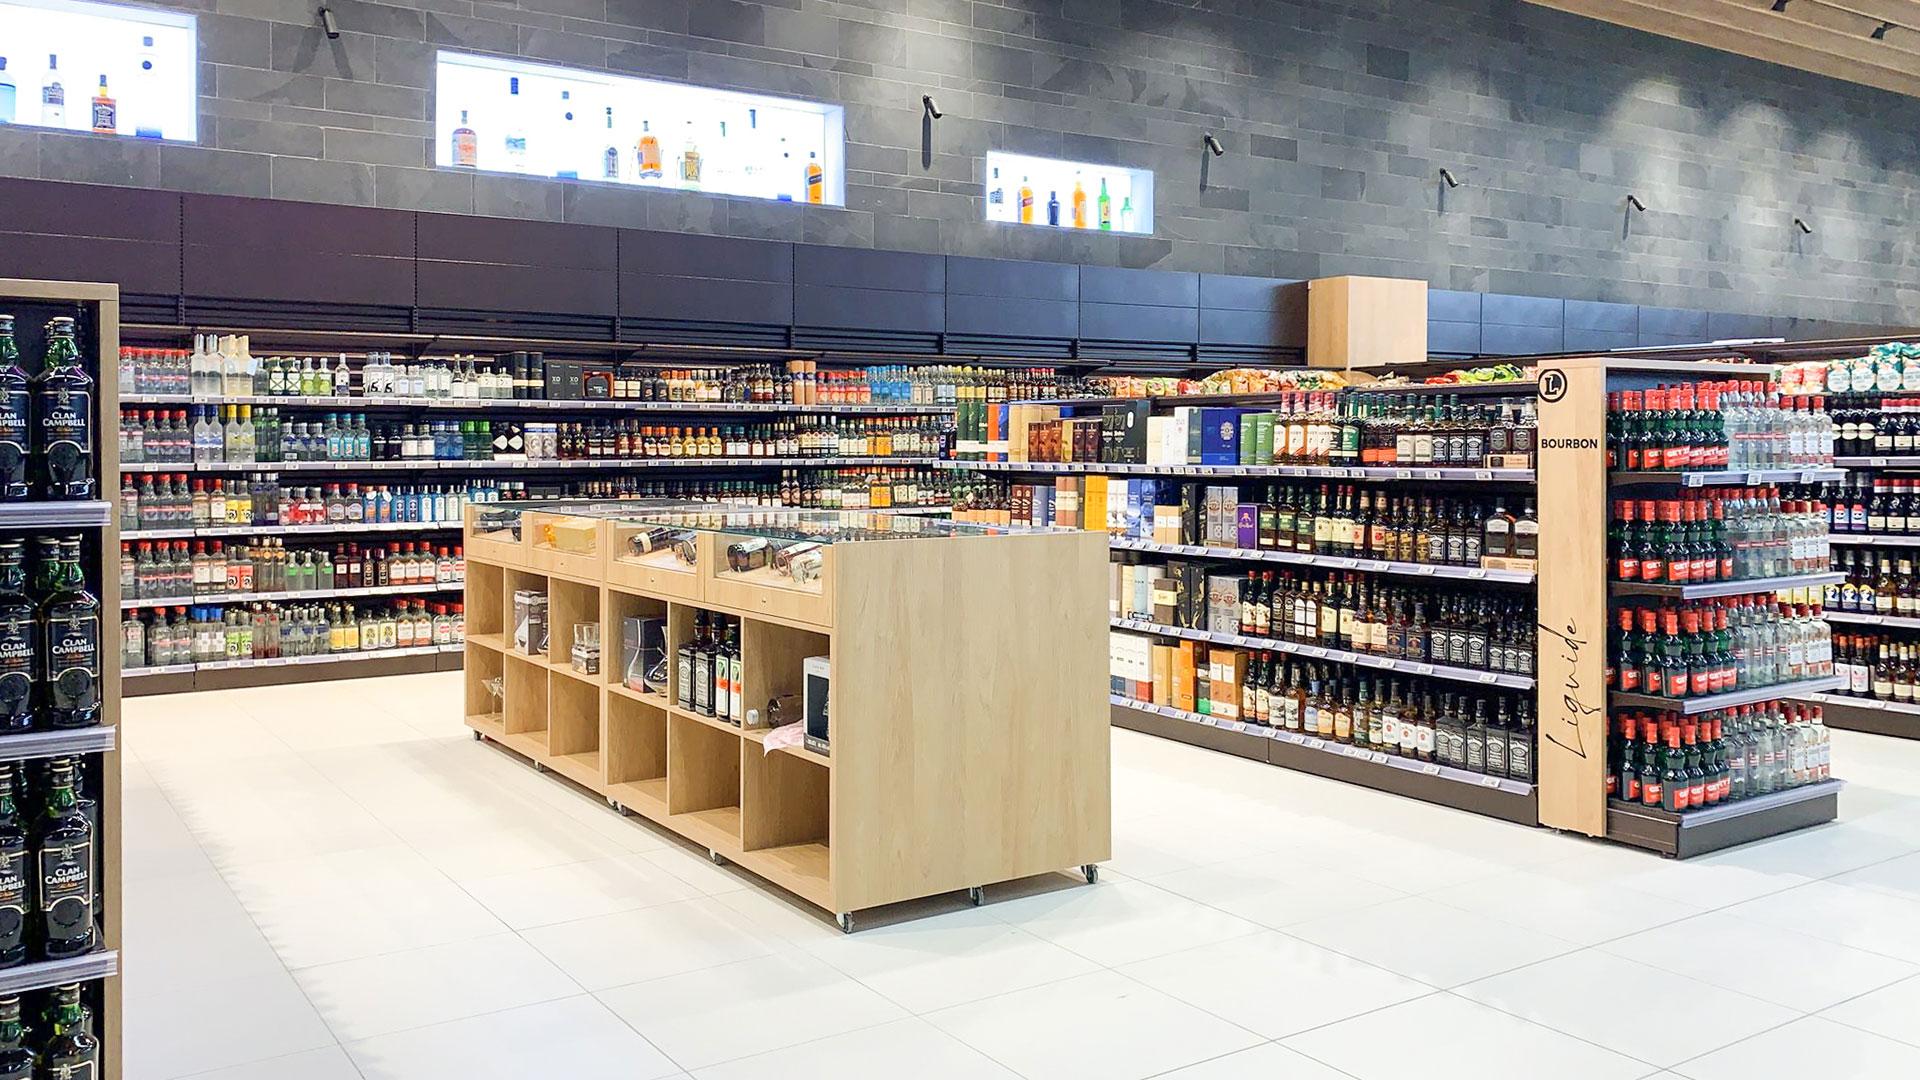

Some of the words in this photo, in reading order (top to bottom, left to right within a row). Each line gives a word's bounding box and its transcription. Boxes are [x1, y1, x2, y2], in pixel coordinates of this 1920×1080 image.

[0, 412, 18, 420] LAN
[43, 418, 85, 426] CAMPBELL
[1541, 439, 1598, 449] BOURBON
[1, 642, 26, 651] CLAN
[63, 638, 87, 647] CLAN
[0, 647, 35, 658] AMPBELL
[52, 643, 95, 654] CAMPBELL
[1538, 617, 1601, 759] Liquide
[55, 866, 80, 876] CLAN
[0, 875, 17, 884] LAN
[45, 870, 88, 884] CAMPBELL
